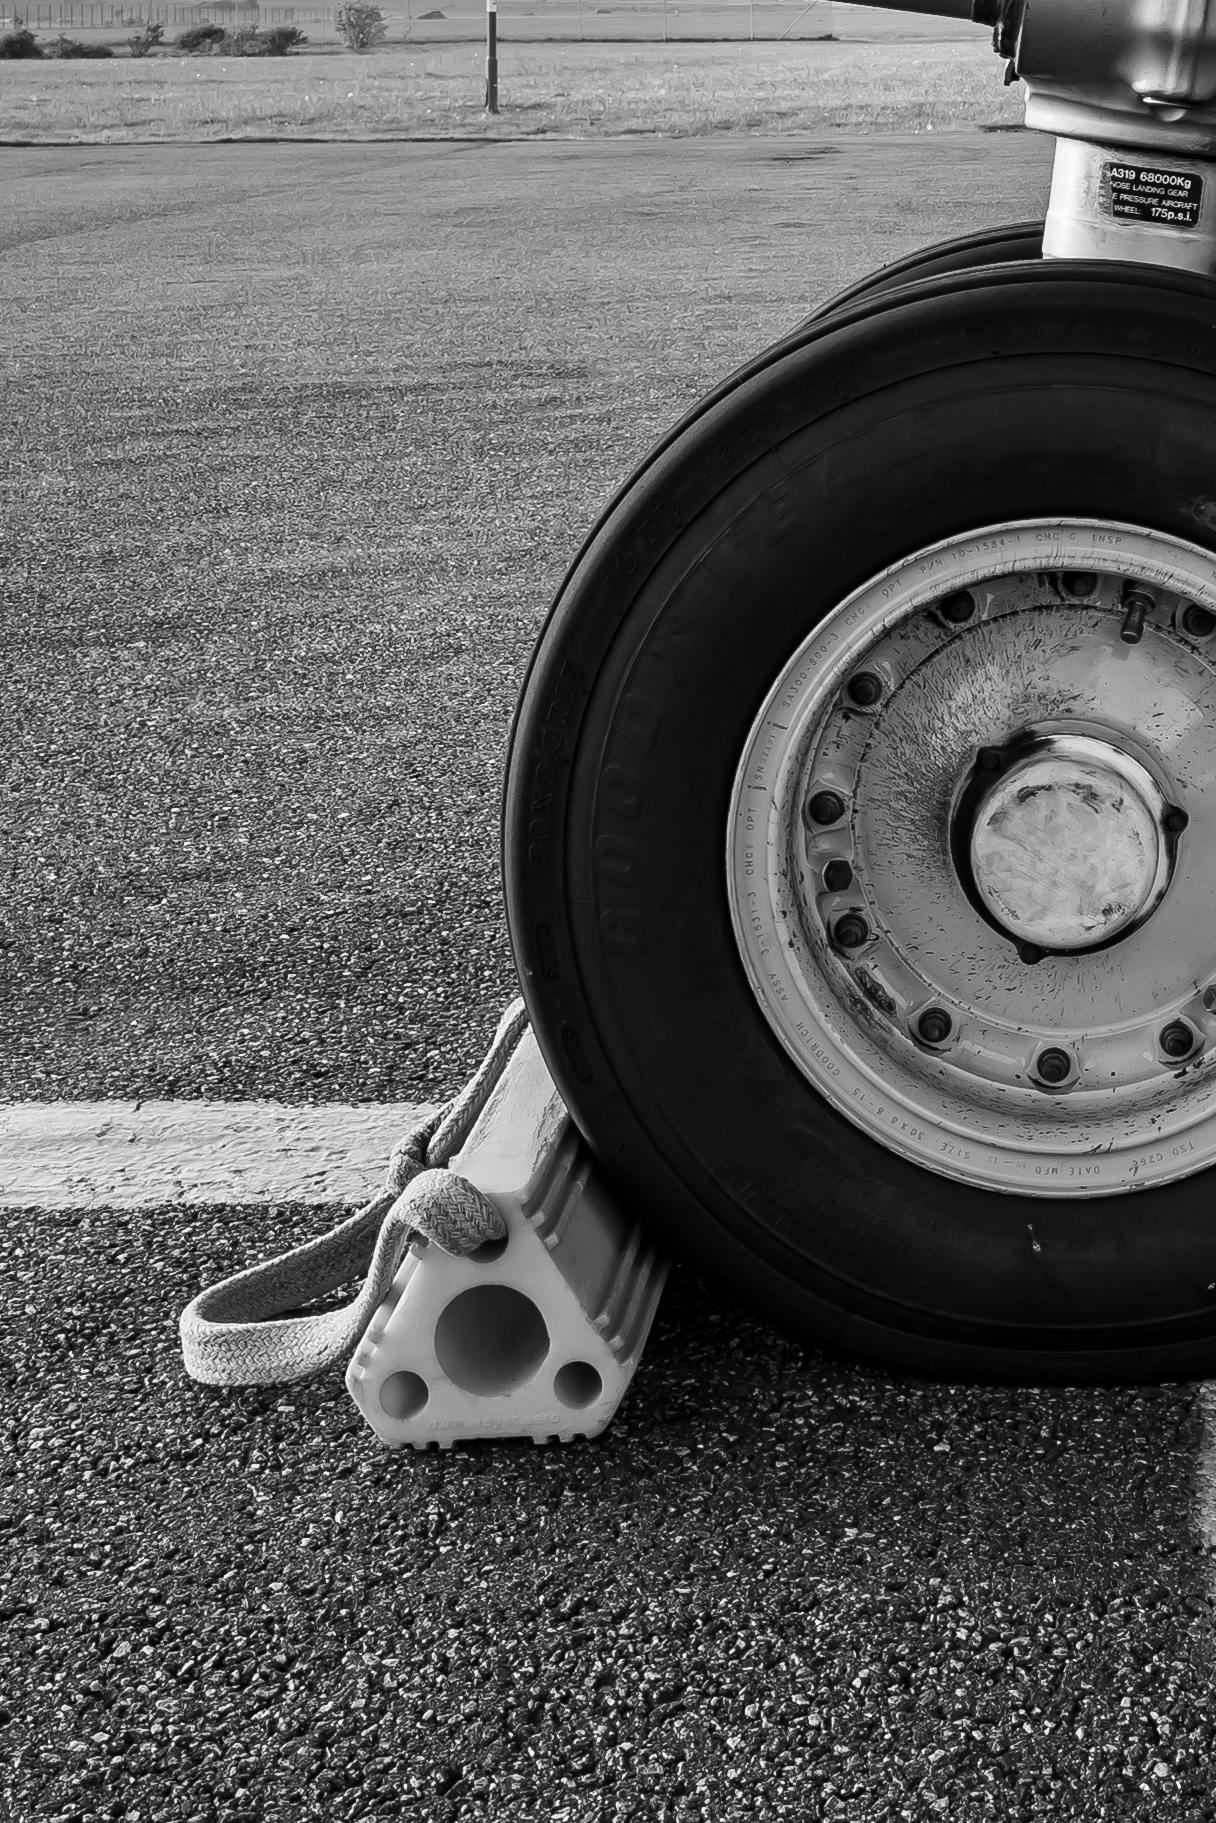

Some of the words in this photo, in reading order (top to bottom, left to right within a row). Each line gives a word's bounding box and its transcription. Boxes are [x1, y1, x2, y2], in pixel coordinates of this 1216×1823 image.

[1111, 168, 1135, 179] A319
[1140, 172, 1192, 189] 68000Kg
[1133, 184, 1165, 195] LANDING
[1168, 189, 1188, 198] GEAR
[1120, 194, 1159, 206] PRESSURE
[1161, 200, 1198, 210] AIRCRAFT
